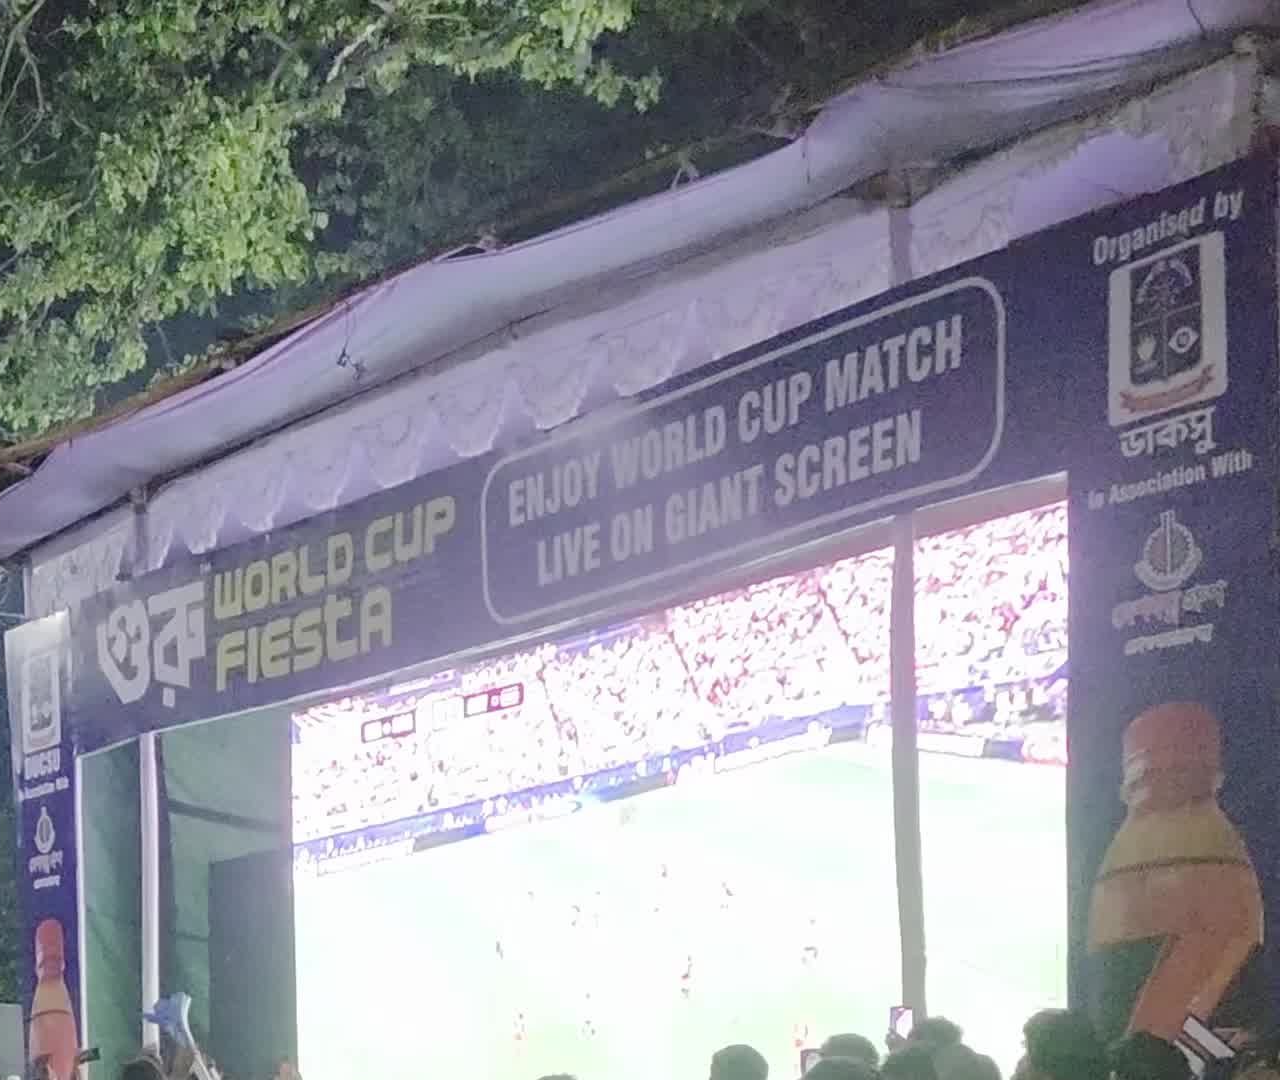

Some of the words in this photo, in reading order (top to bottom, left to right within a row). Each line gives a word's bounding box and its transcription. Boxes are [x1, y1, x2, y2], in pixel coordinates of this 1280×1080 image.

[1213, 191, 1244, 221] by
[508, 453, 600, 528] ENJOY
[611, 405, 726, 490] WORLD
[739, 371, 812, 444] CUP
[825, 314, 962, 414] MATCH
[1120, 406, 1217, 458] ডাকসু
[538, 525, 600, 587] LIVE
[611, 506, 654, 563] ON
[665, 464, 769, 544] GIANT
[774, 410, 922, 507] SCREEN
[1109, 464, 1206, 504] Association
[1211, 449, 1253, 478] With
[214, 533, 353, 620] WORLD
[365, 495, 456, 572] CUP
